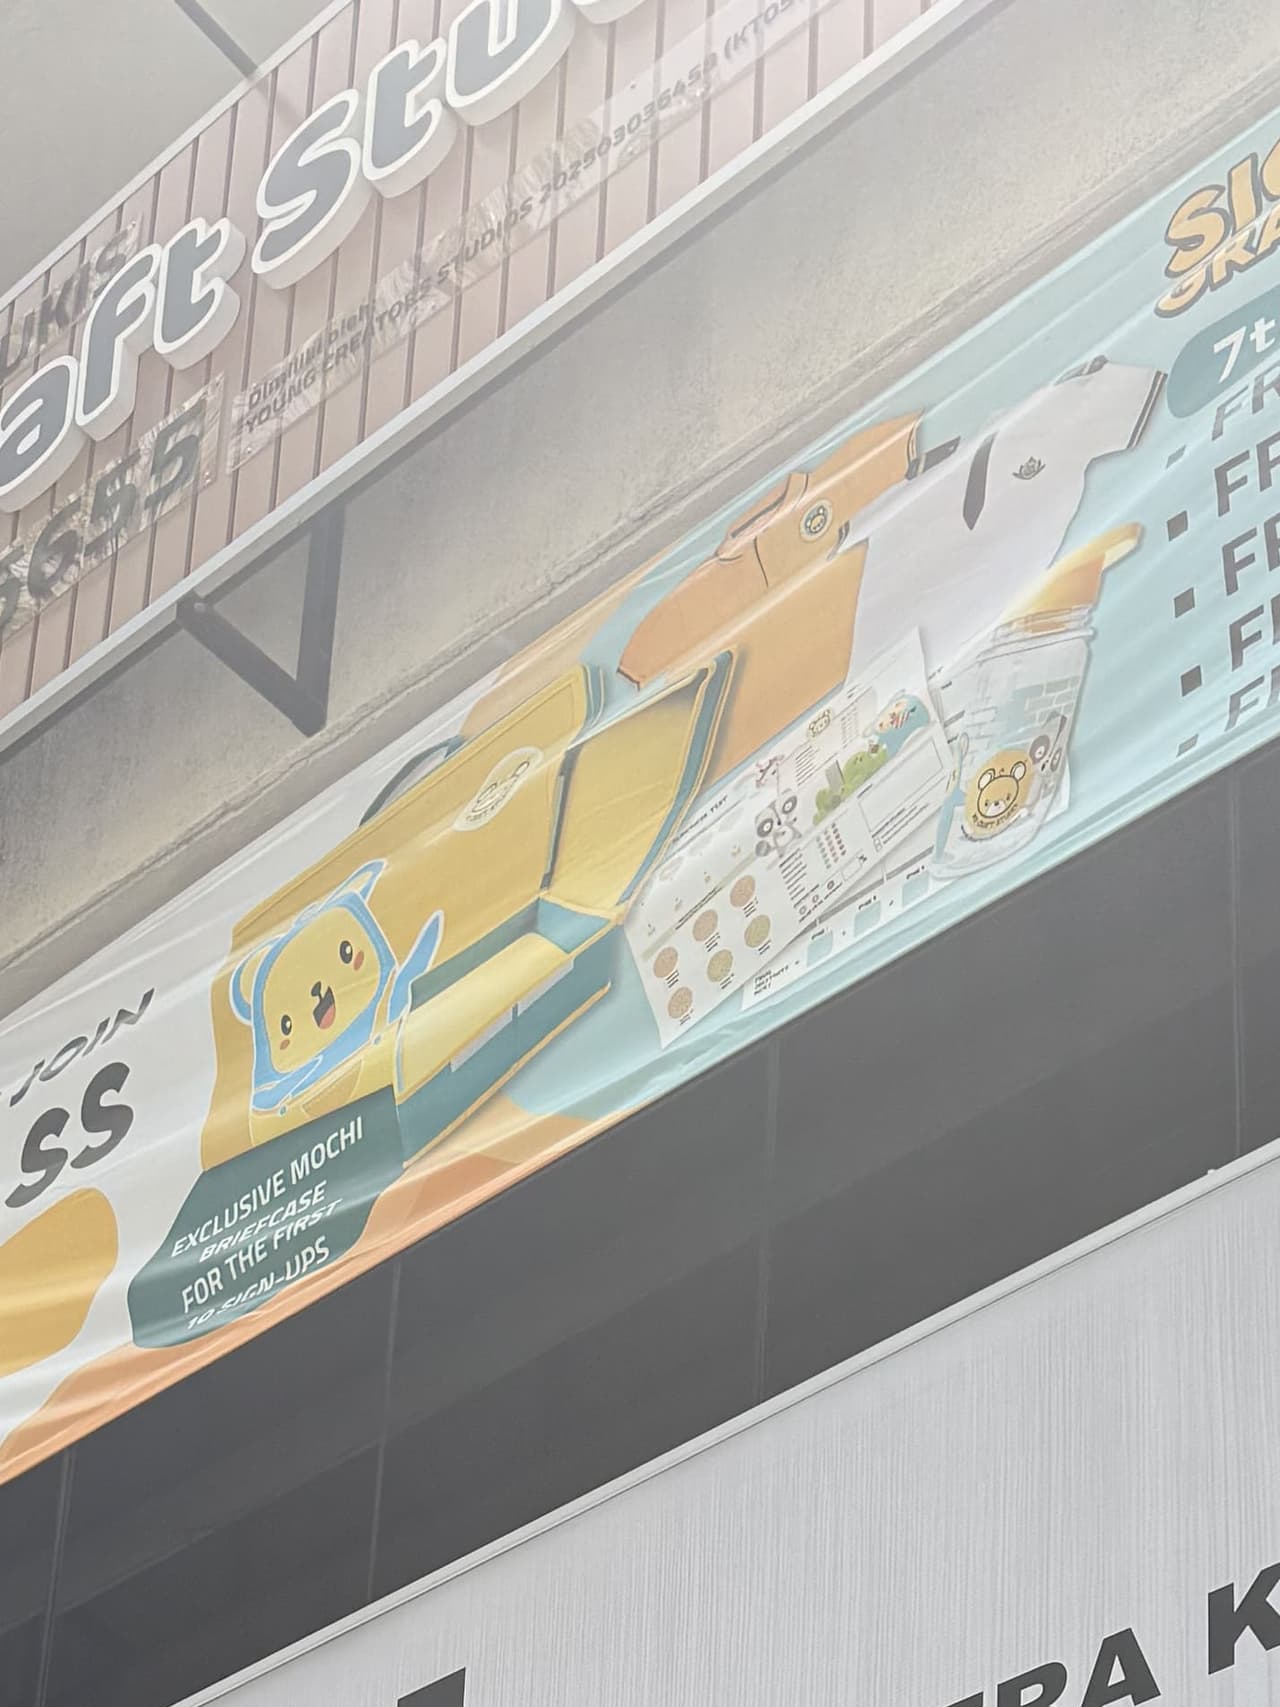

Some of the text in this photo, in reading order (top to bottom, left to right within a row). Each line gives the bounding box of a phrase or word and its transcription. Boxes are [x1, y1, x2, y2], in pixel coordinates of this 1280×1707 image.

[252, 0, 645, 290] Stu
[9, 989, 155, 1108] JOIN
[171, 1115, 364, 1259] EXCLUSIVE MOCHI
[199, 1180, 328, 1263] BRIEFCASE
[181, 1198, 344, 1313] FOR THE FIRST
[218, 1236, 330, 1315] SIGN-UPS
